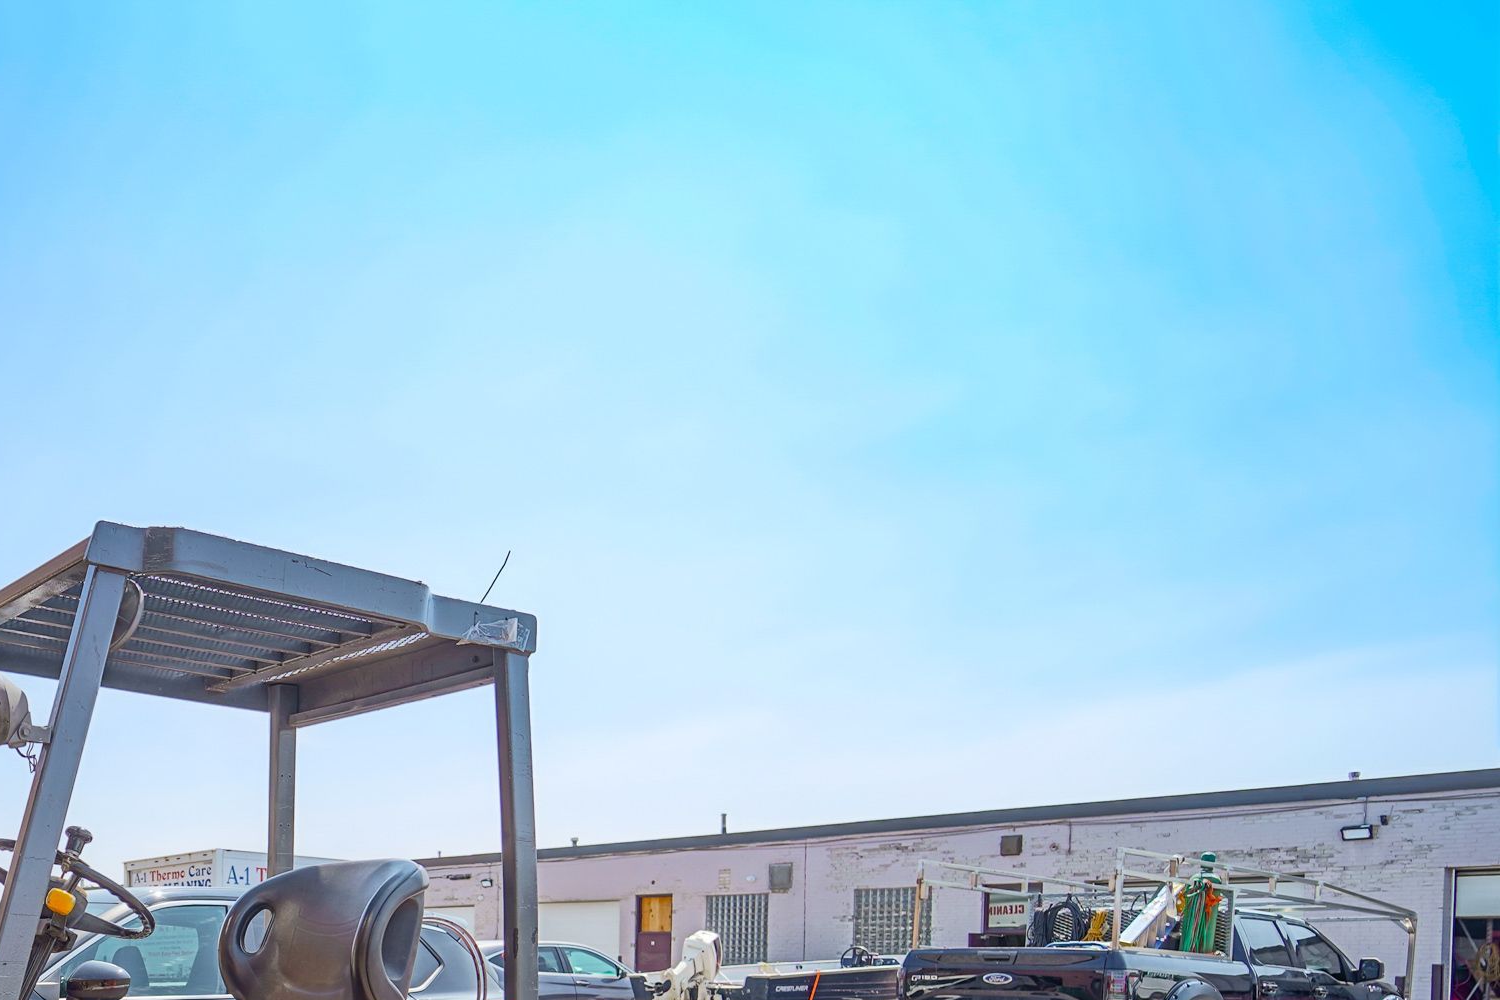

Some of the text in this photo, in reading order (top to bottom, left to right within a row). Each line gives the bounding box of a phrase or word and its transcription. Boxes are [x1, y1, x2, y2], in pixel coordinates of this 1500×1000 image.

[134, 865, 212, 884] A-1 Thermo Care
[226, 865, 250, 886] A-1
